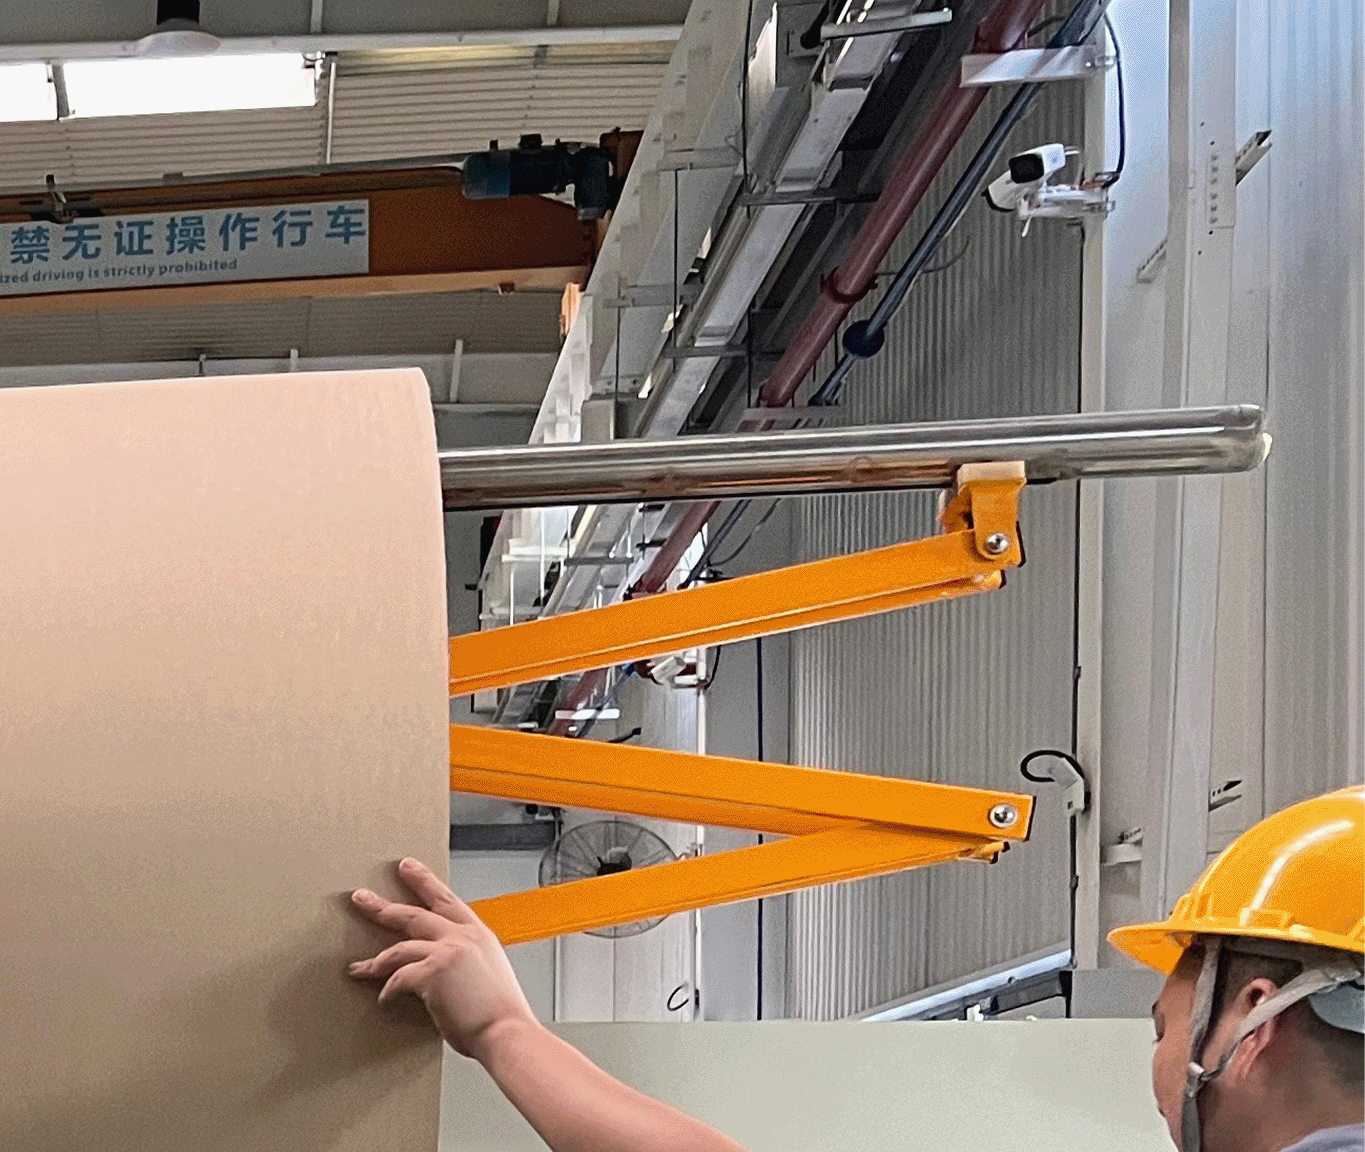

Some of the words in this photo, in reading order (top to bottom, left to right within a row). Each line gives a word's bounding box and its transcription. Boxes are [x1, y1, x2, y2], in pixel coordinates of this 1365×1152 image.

[32, 266, 84, 284] driving
[87, 265, 100, 279] is
[103, 262, 155, 279] strictly
[158, 257, 238, 277] prohibited
